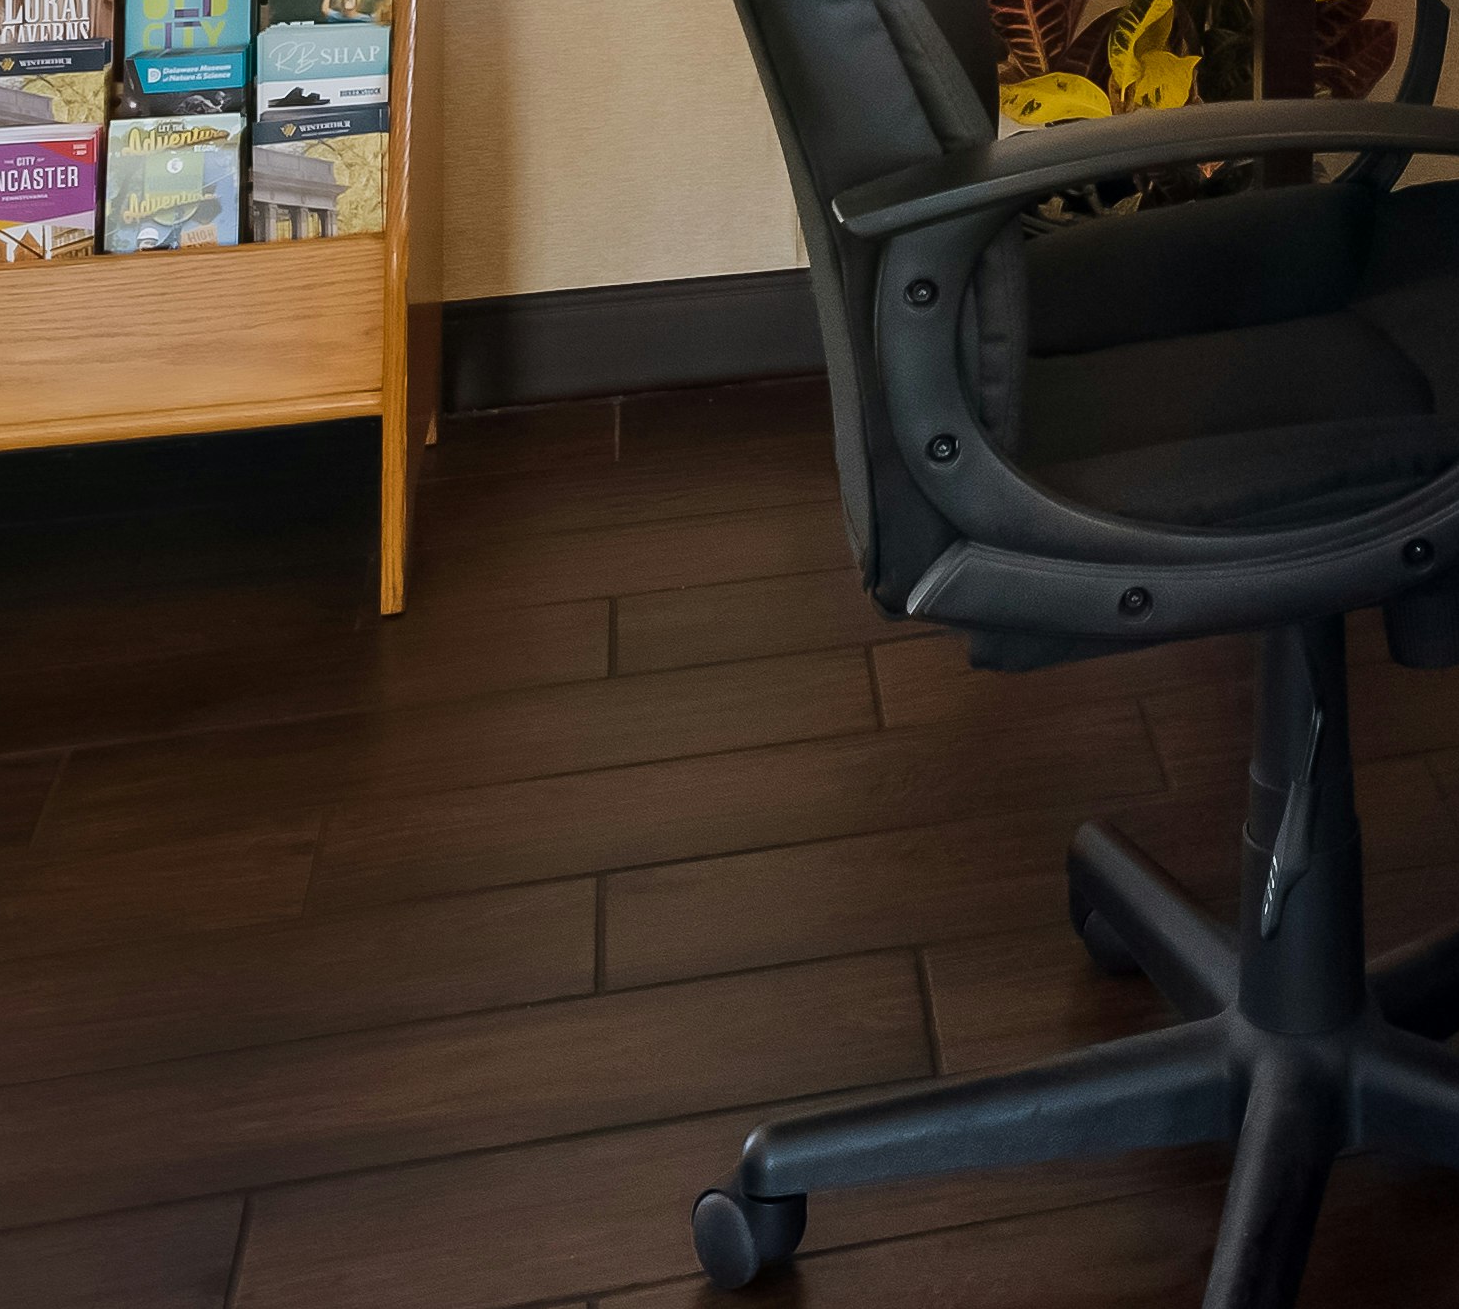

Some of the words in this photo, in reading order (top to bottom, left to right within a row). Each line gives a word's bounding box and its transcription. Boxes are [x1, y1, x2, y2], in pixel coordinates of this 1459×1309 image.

[320, 45, 380, 65] SHAP
[122, 127, 231, 157] Adventure
[16, 156, 36, 166] CITY
